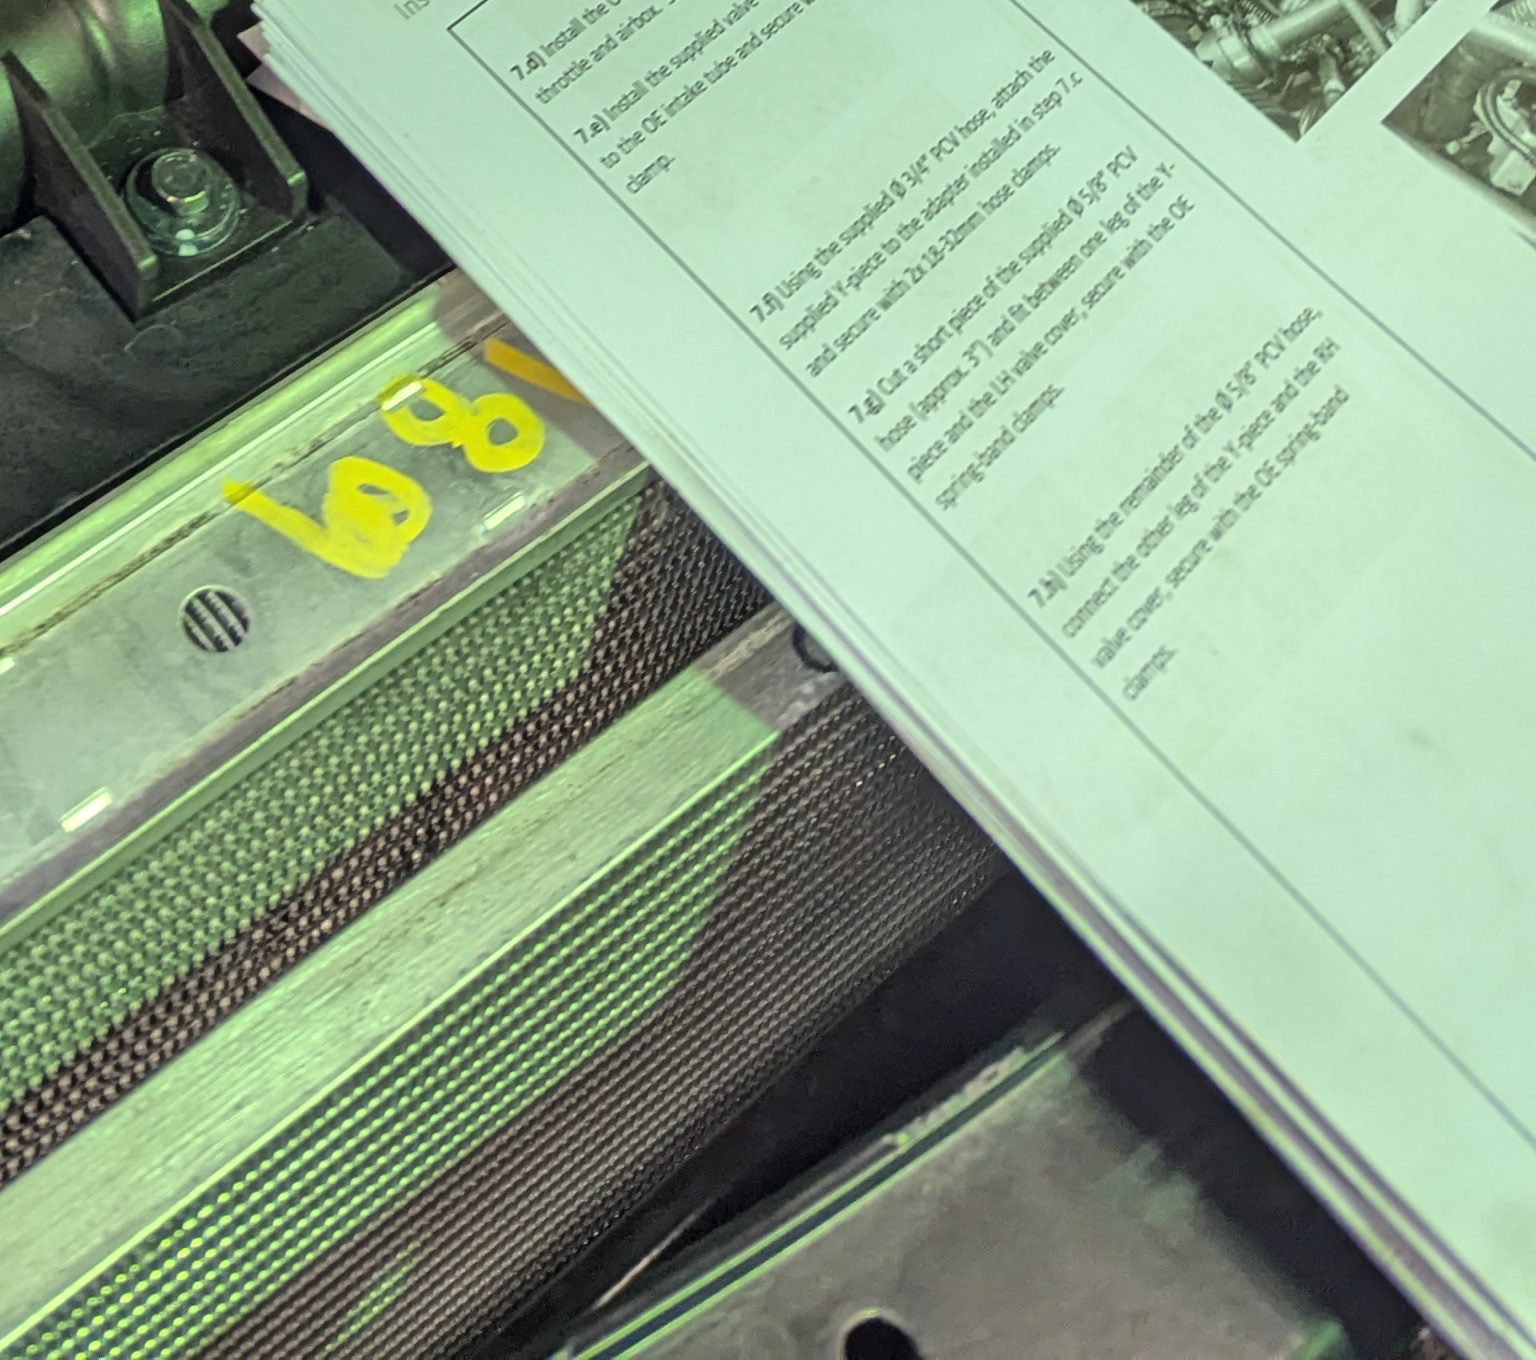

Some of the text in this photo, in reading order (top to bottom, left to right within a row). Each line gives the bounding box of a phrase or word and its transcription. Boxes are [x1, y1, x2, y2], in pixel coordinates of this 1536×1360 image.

[509, 50, 548, 81] 7.d)
[538, 16, 587, 58] Install
[581, 3, 610, 25] the
[535, 58, 593, 105] throttle
[589, 33, 619, 63] and
[615, 5, 664, 42] airbox.
[573, 114, 611, 145] 7.e)
[601, 79, 650, 122] Install
[644, 64, 673, 88] the
[669, 18, 727, 70] supplied
[599, 151, 622, 169] to
[616, 130, 647, 156] the
[641, 109, 668, 134] OE
[659, 80, 708, 118] intake
[703, 55, 739, 85] tube
[734, 31, 764, 60] and
[759, 2, 804, 41] secure
[748, 291, 785, 323] 7.f)
[774, 261, 823, 299] Using
[813, 241, 843, 267] the
[838, 189, 896, 246] supplied
[928, 130, 961, 162] PCV
[990, 69, 1034, 110] attach
[1027, 50, 1056, 74] the
[779, 71, 1083, 351] supplied Y-piece to the adapter installed in step 7.c
[805, 343, 838, 378] and
[833, 307, 882, 353] secure
[875, 279, 911, 311] with
[976, 183, 1016, 215] hose
[1011, 143, 1062, 188] clamps.
[876, 368, 909, 396] Cut
[902, 359, 918, 375] a
[913, 325, 954, 366] short
[947, 294, 987, 335] piece
[982, 274, 1001, 299] of
[994, 260, 1023, 286] the
[1018, 208, 1074, 266] supplied
[1105, 145, 1138, 178] PCV
